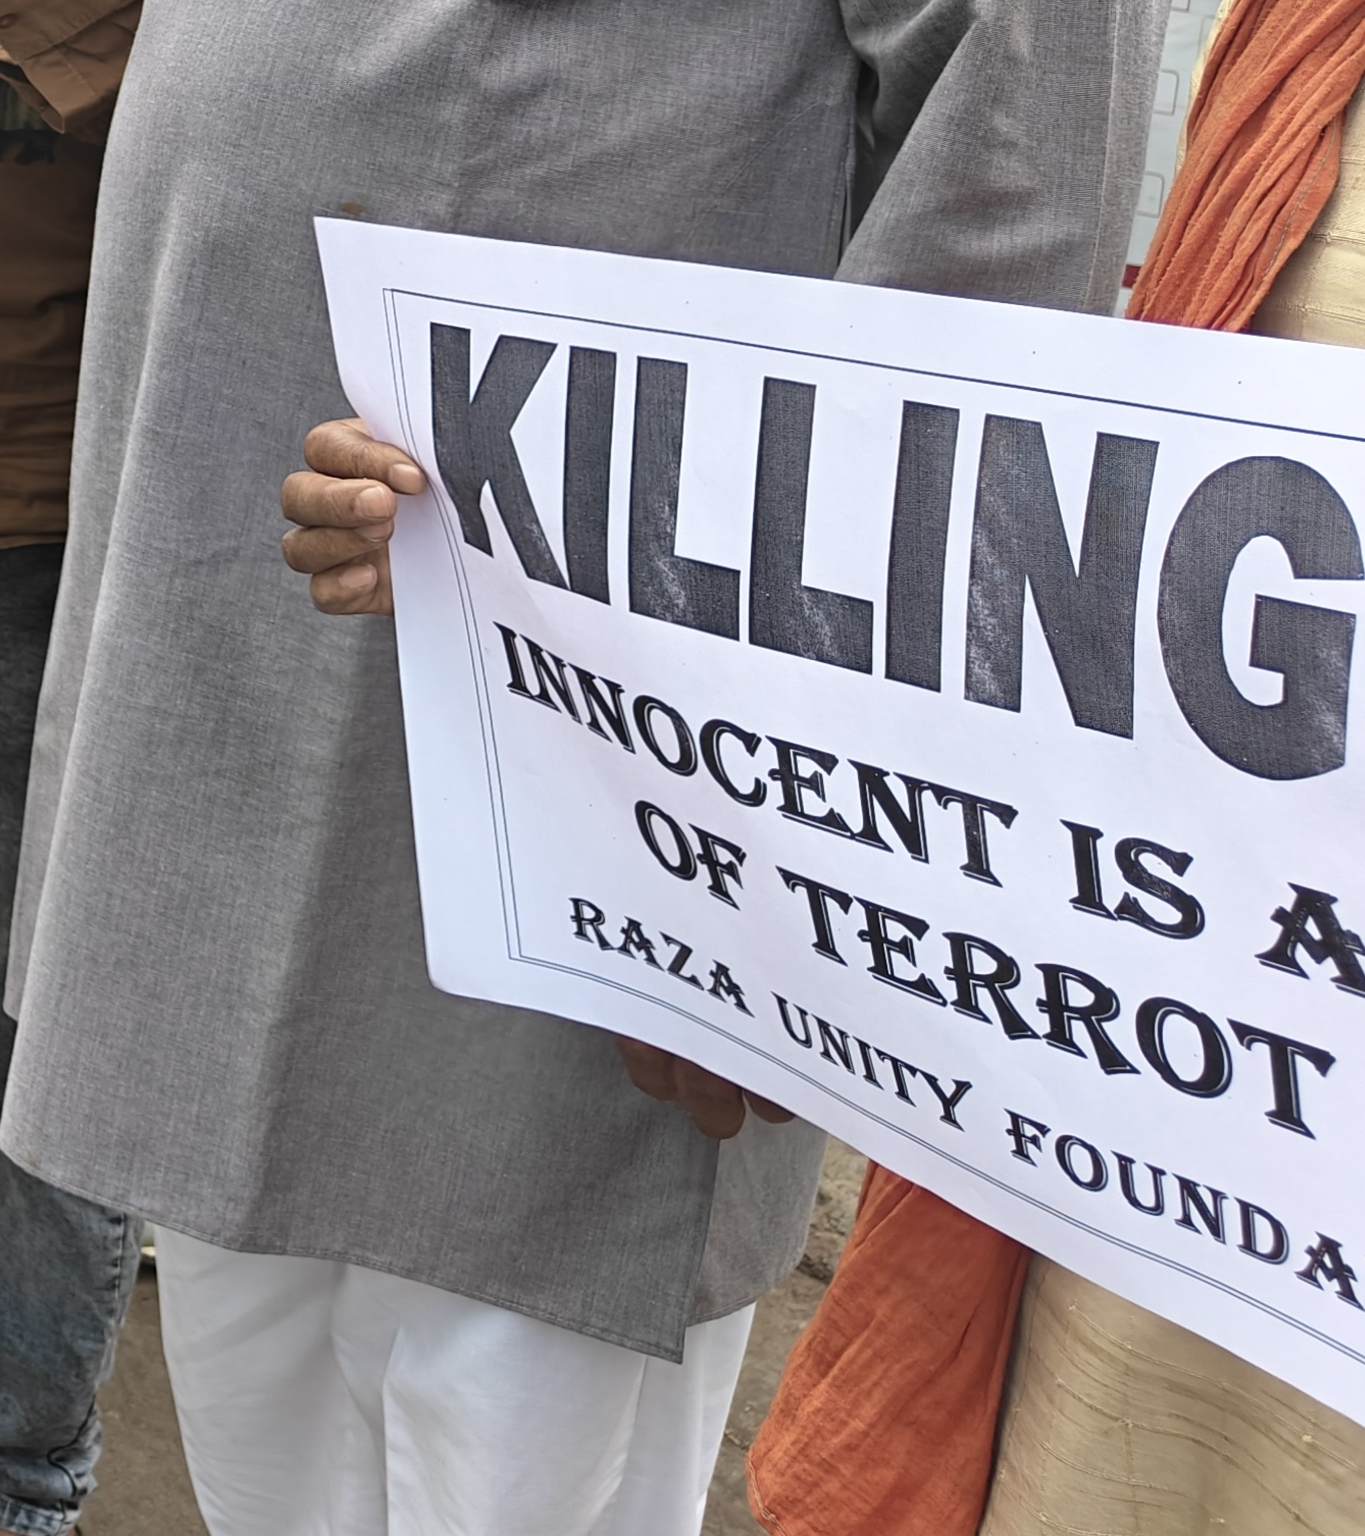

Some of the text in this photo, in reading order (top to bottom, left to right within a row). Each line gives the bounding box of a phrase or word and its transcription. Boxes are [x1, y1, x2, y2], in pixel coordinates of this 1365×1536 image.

[429, 321, 1365, 781] KILLING
[492, 621, 1365, 995] INNOCENT IS A
[634, 799, 1337, 1140] OF TERROT
[569, 897, 1365, 1312] RAZA UNITY FOUNDA
